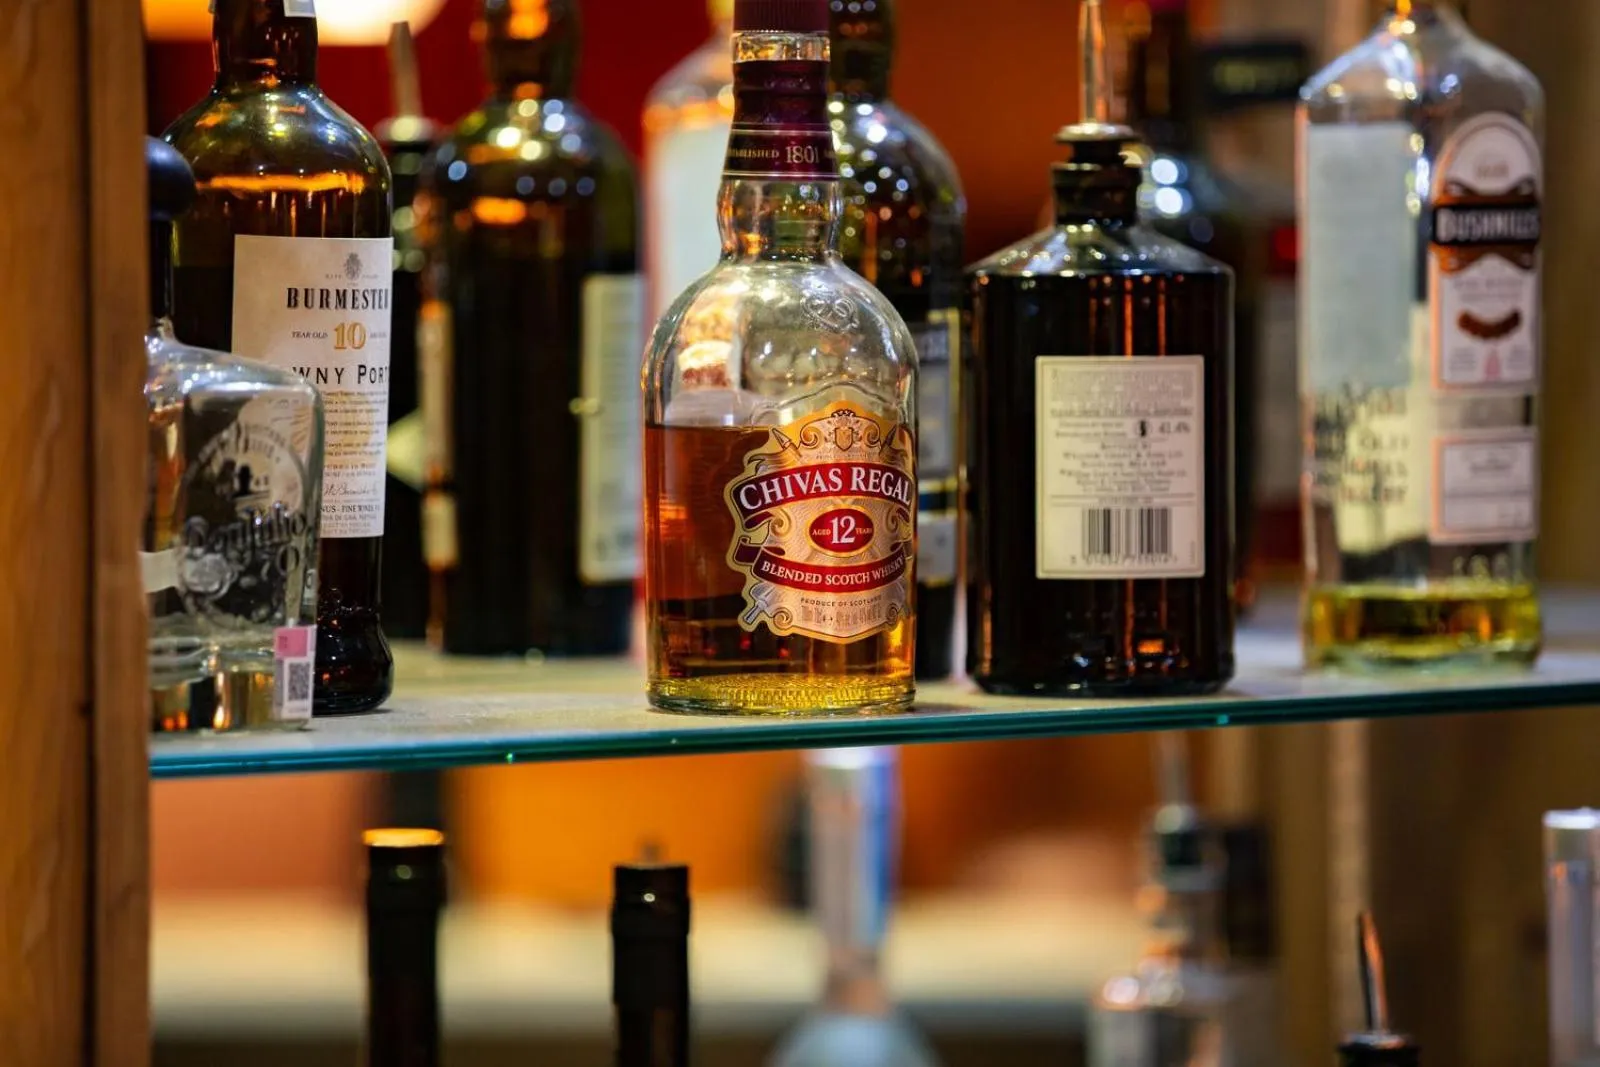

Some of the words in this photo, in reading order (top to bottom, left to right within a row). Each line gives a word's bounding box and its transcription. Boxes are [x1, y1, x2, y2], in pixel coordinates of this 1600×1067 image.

[785, 145, 819, 164] 1801
[292, 331, 311, 339] YEAR
[312, 331, 328, 339] OLD
[333, 322, 366, 350] 10
[292, 366, 345, 385] WNY
[739, 467, 843, 510] CHIVAS
[850, 466, 911, 506] REGAL
[812, 528, 831, 536] AGED
[830, 515, 856, 544] 12
[761, 560, 822, 585] BLENDED
[825, 572, 870, 586] SCOTCH
[871, 554, 905, 580] WHISKY
[800, 597, 835, 607] PRODUCE
